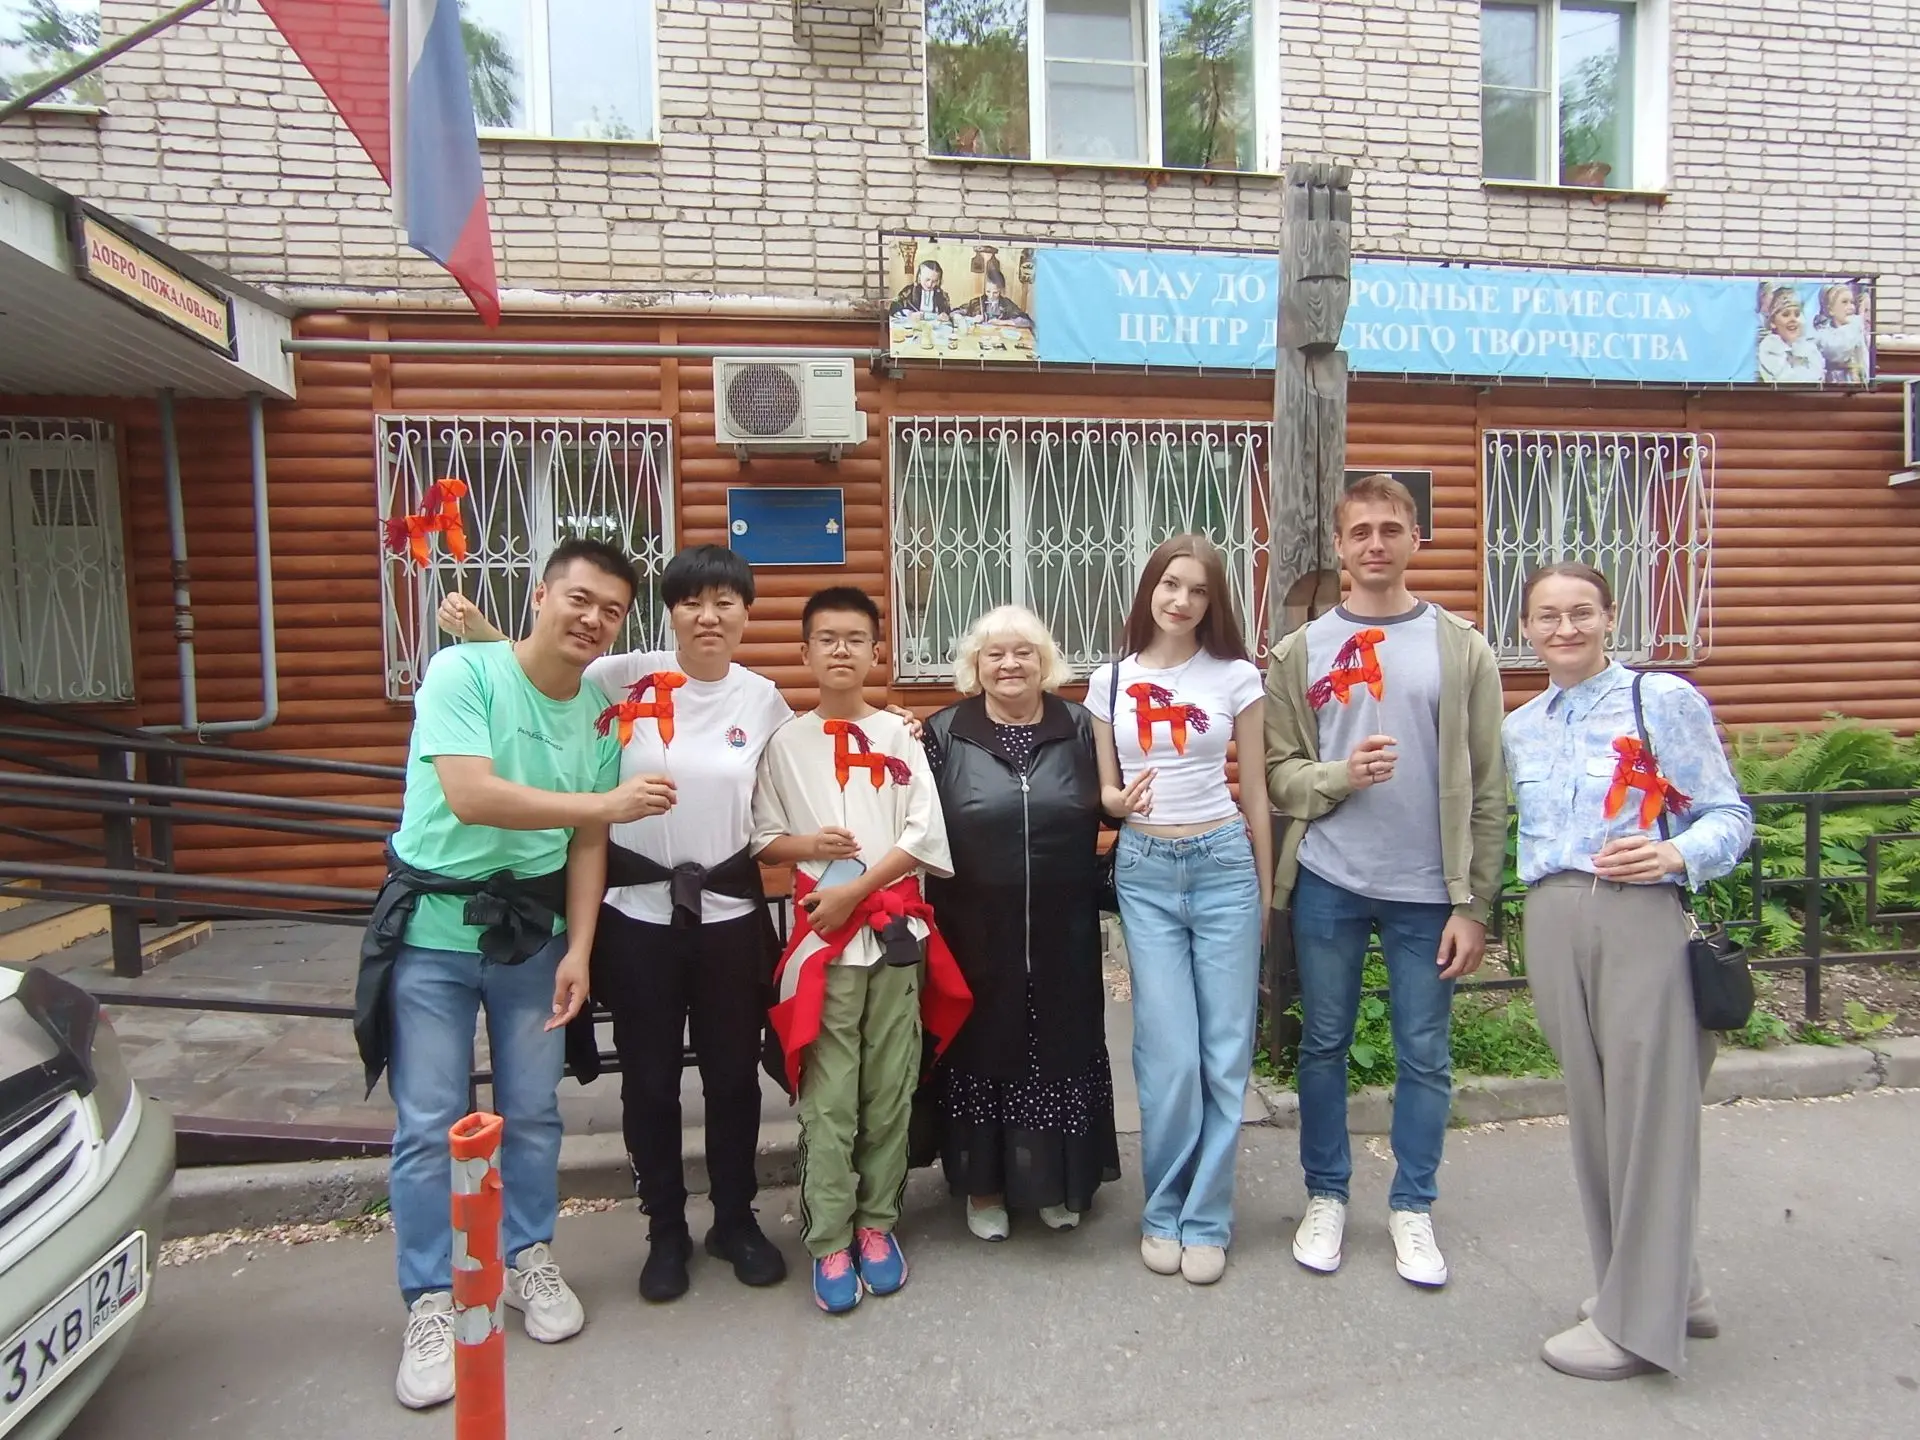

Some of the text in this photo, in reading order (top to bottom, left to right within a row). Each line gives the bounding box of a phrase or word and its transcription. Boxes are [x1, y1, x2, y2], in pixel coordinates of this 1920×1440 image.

[92, 240, 223, 331] ДОБРО ПОЖАЛОВАТЬ!
[1115, 268, 1692, 321] МАУ ДО РОДНЫЕ РЕМЕСЛА»
[1117, 313, 1690, 362] ЦЕНТР ДСКОГО ТВОРЧЕСТВА
[94, 1252, 129, 1313] 27
[92, 1299, 118, 1331] RUS
